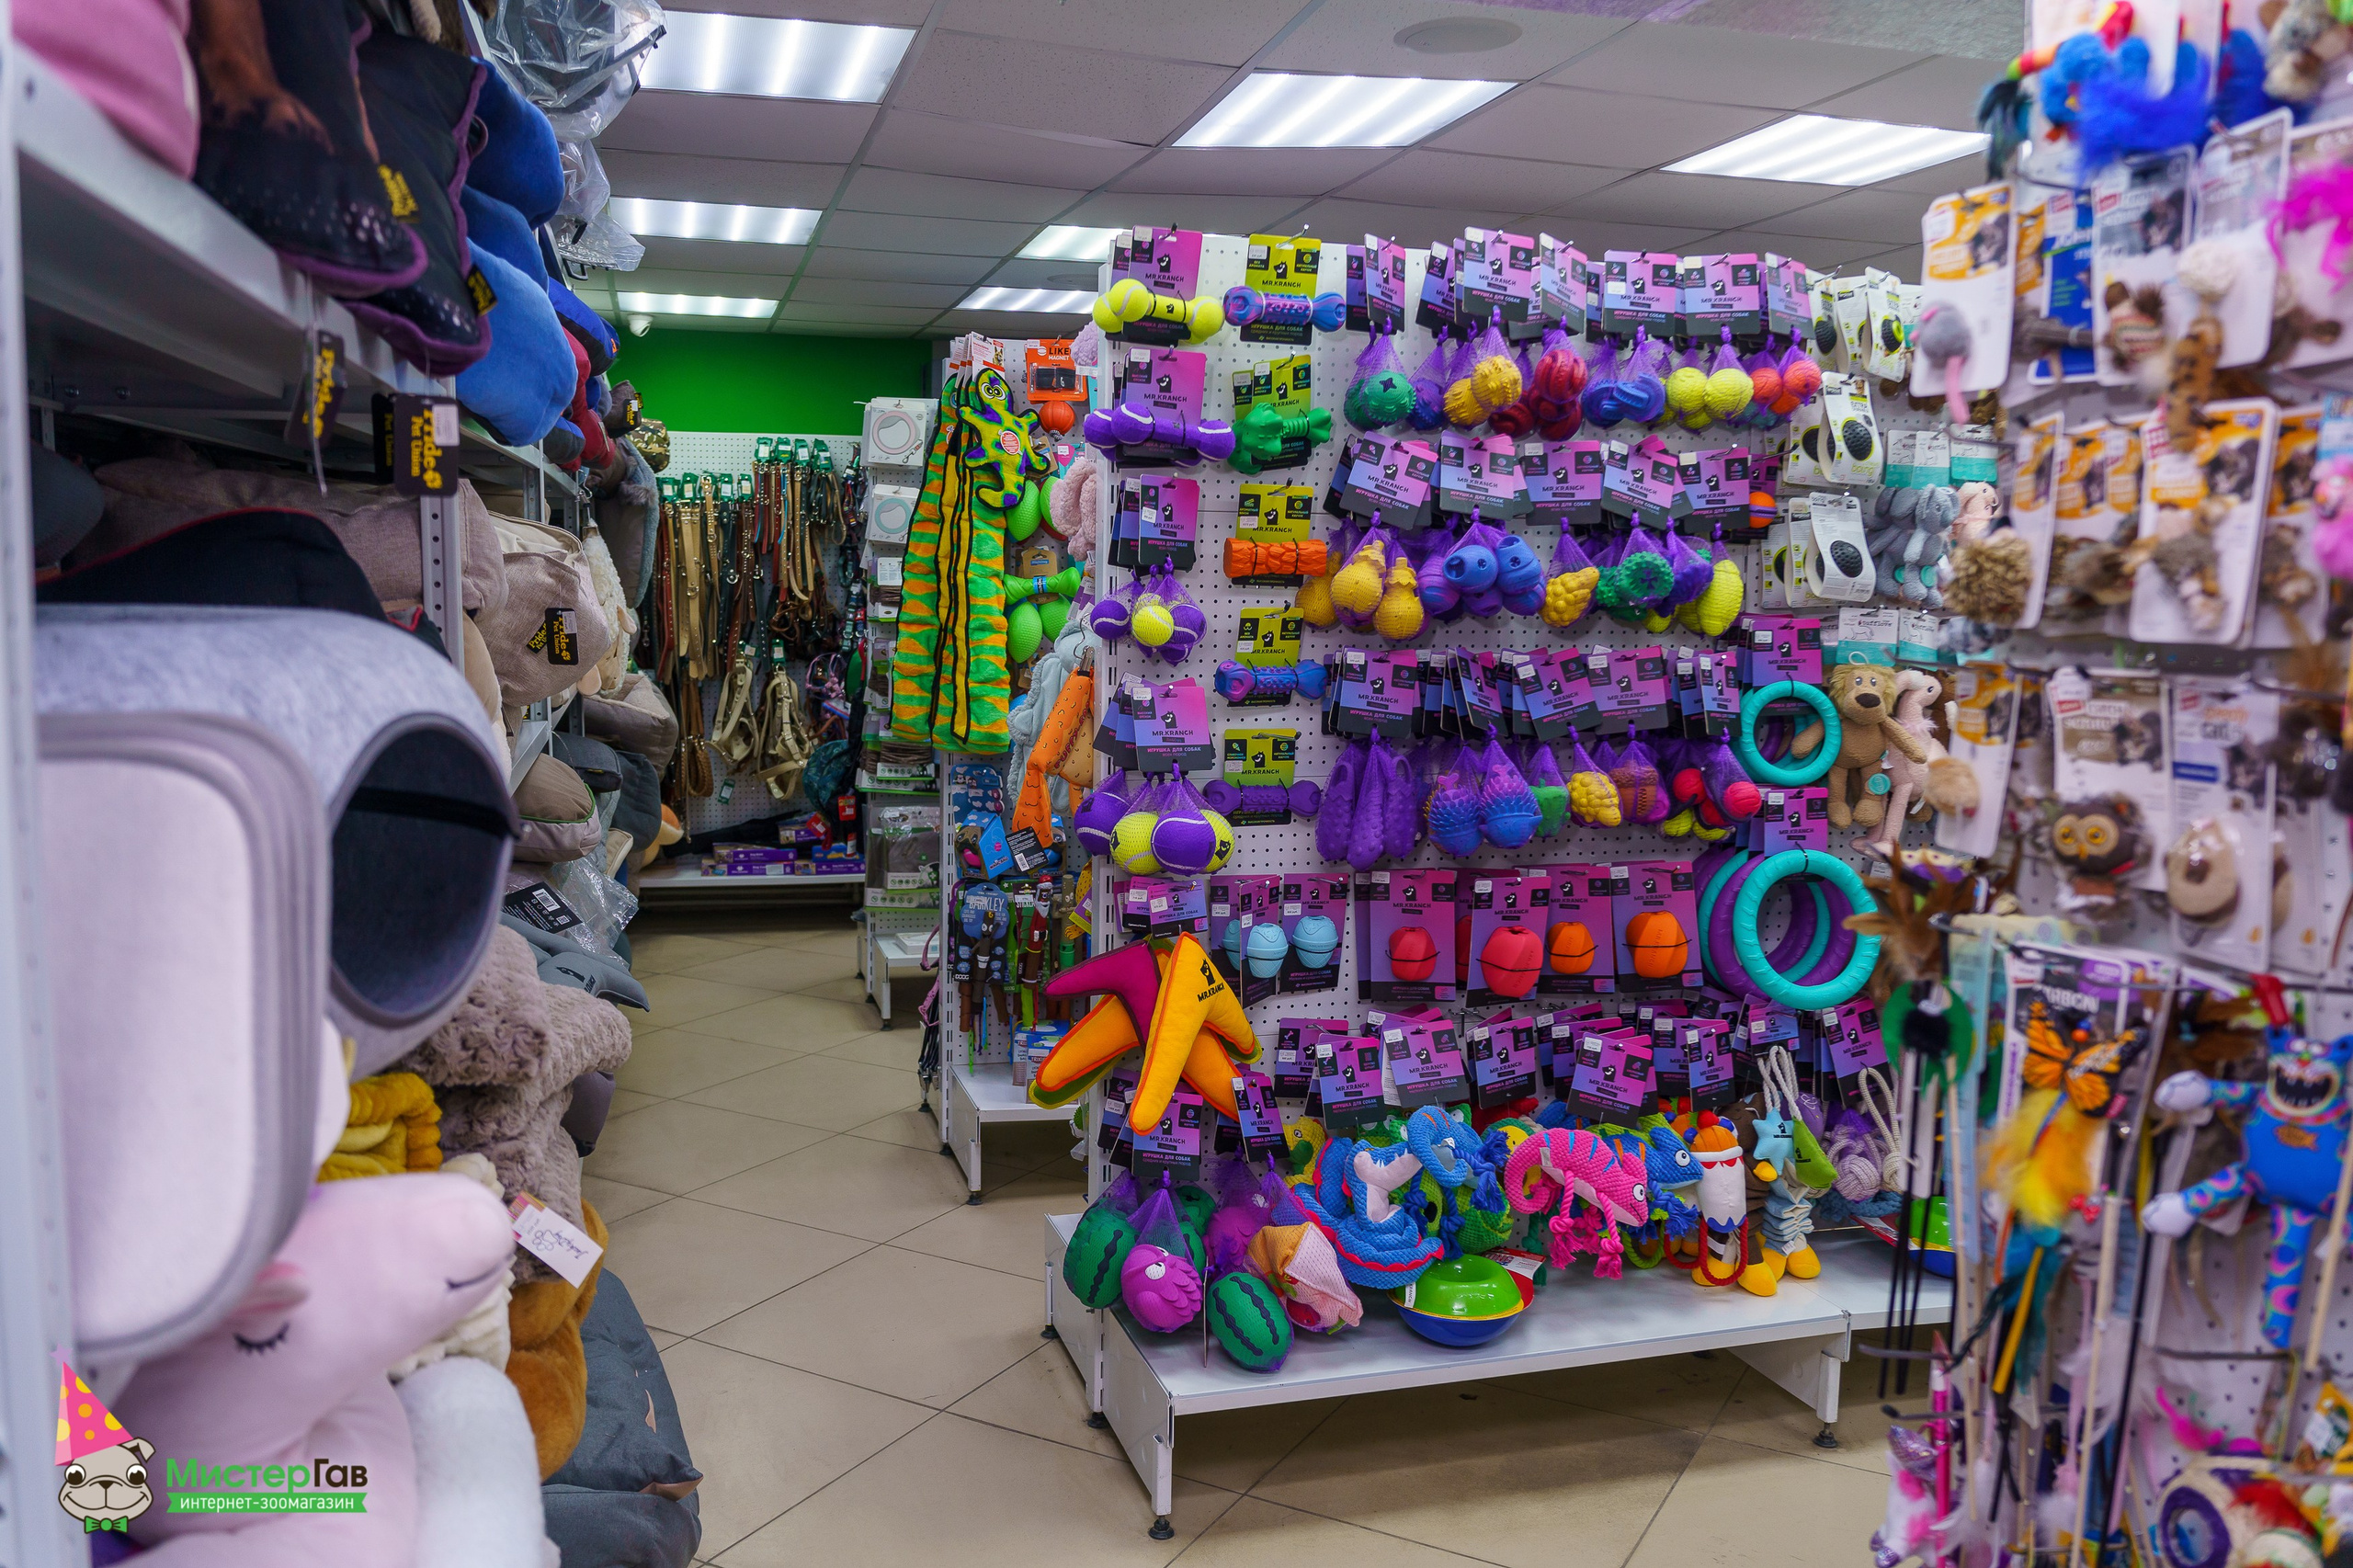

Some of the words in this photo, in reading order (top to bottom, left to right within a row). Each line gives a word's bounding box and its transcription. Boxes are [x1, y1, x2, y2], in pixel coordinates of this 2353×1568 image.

[1145, 272, 1185, 283] MR.KRANCH
[1262, 279, 1302, 288] MR.KRANCH
[1144, 393, 1187, 403] MR.KRANCH
[411, 415, 423, 441] Pet
[411, 443, 423, 477] Union
[1368, 474, 1409, 493] MR.KRANCH
[1457, 477, 1498, 488] MR.KRANCH
[1620, 479, 1657, 495] MR.KRANCH
[1697, 491, 1734, 500] MR.KRANCH
[529, 628, 547, 649] Pride
[1358, 694, 1399, 704] MR.KRANCH
[1543, 692, 1578, 706] MR.KRANCH
[1608, 692, 1649, 700] MR.KRANCH
[1198, 982, 1225, 1003] MR.KRANCH
[1409, 1062, 1449, 1074] MR.KRANCH
[1489, 1062, 1522, 1074] MR.KRANCH
[1336, 1082, 1370, 1092] MR.KRANCH
[1589, 1079, 1628, 1093] MR.KRANCH
[1150, 1135, 1186, 1144] MR.KRANCH
